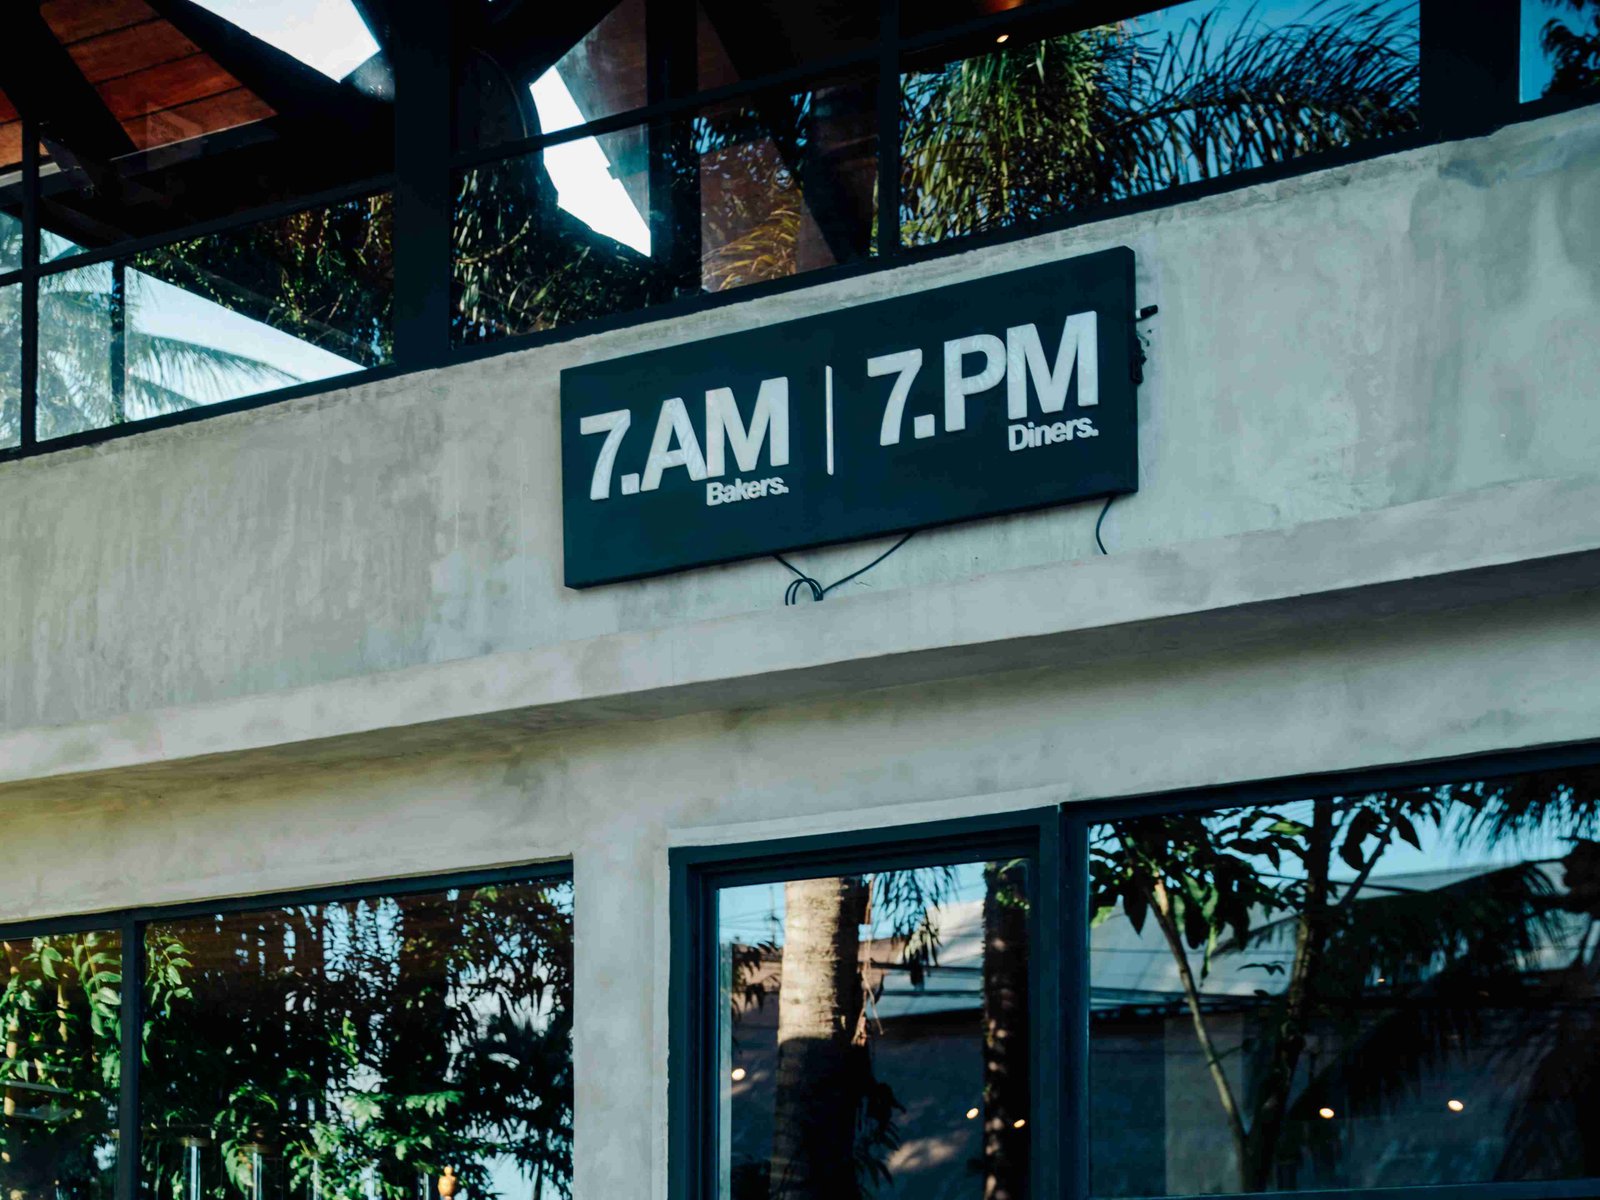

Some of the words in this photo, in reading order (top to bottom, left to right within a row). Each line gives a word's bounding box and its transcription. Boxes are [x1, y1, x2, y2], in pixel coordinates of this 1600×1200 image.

[580, 376, 789, 500] 7.AM
[867, 310, 1099, 446] 7.PM
[1008, 417, 1099, 451] Diners.
[706, 477, 789, 506] Bakers.
